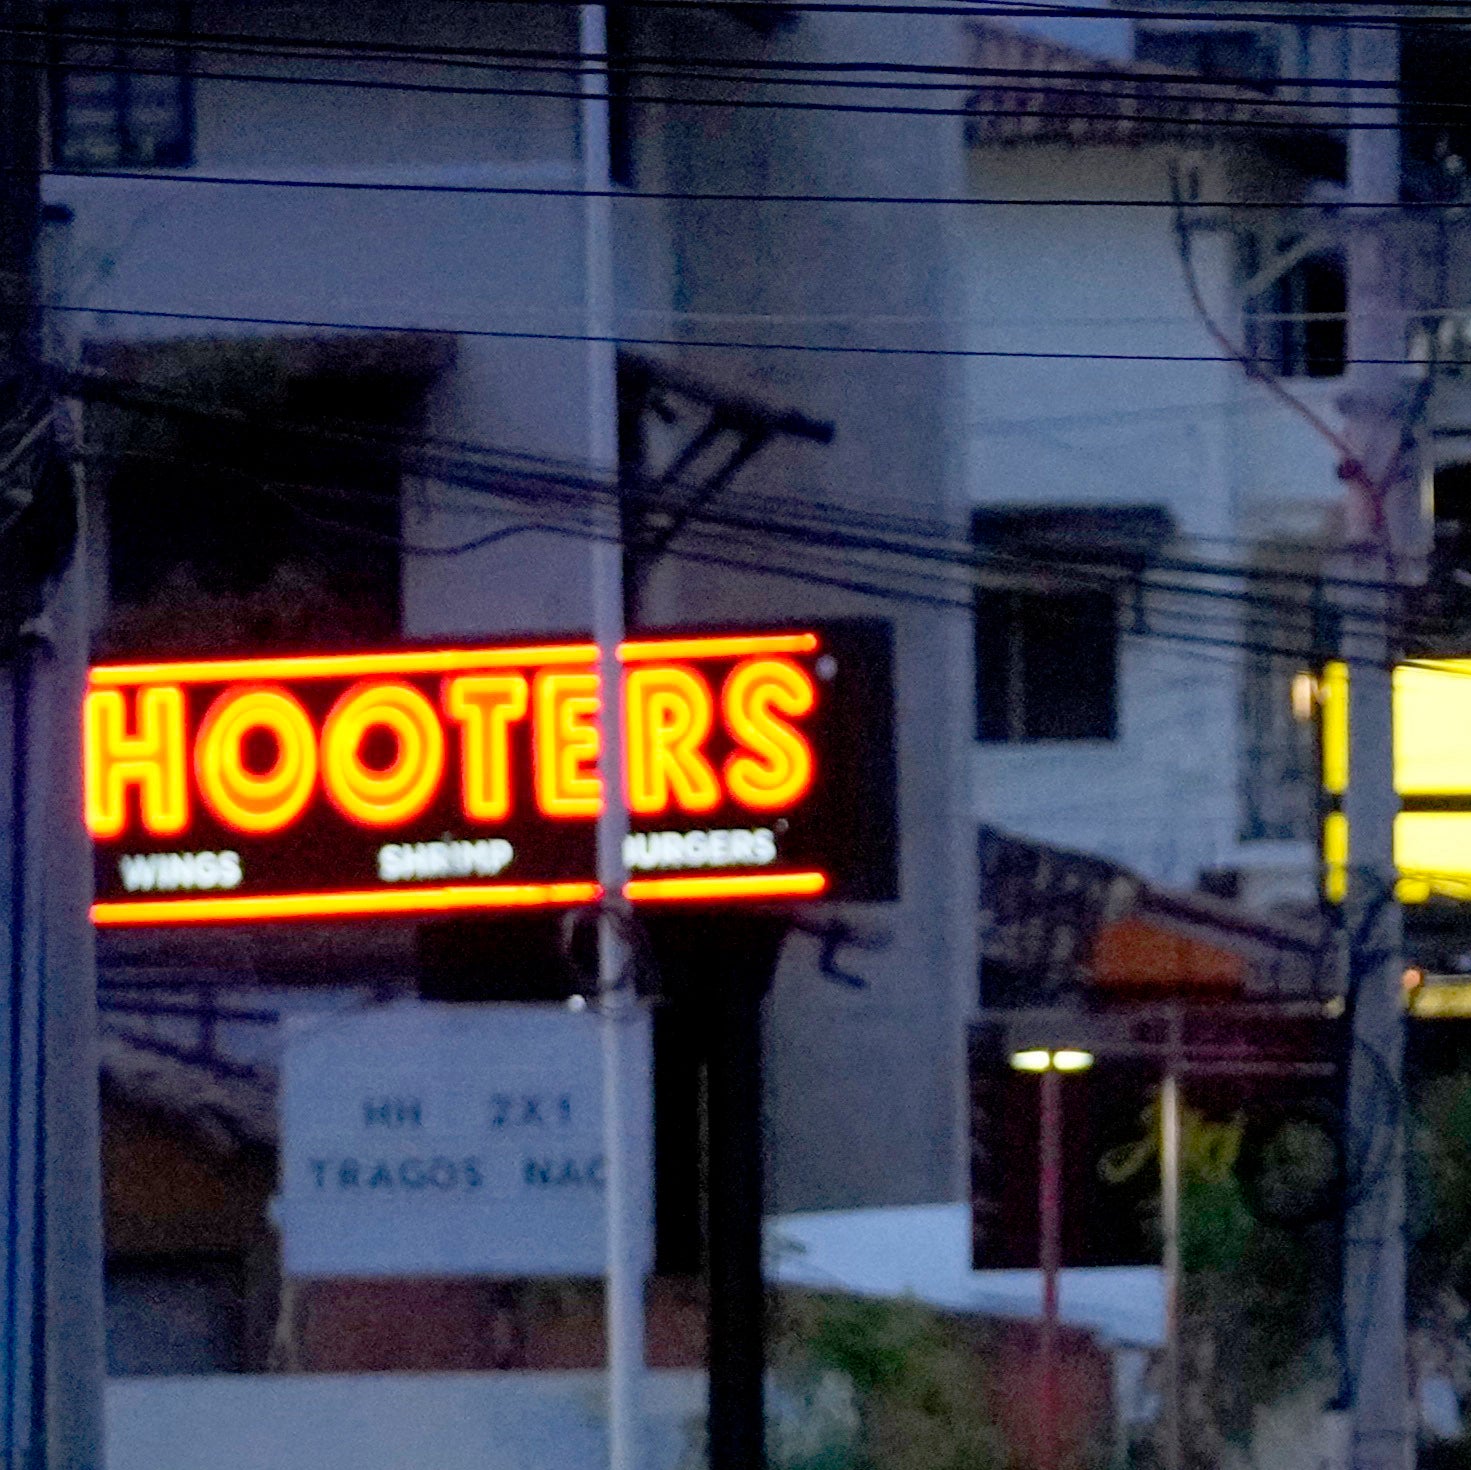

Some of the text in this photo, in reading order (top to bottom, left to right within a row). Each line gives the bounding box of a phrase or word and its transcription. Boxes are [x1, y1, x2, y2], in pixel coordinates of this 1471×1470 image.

[84, 657, 816, 837] HOOTERS
[120, 851, 243, 891] WINGS
[378, 838, 514, 882] SHRIMP
[310, 1156, 484, 1190] TRAGOS
